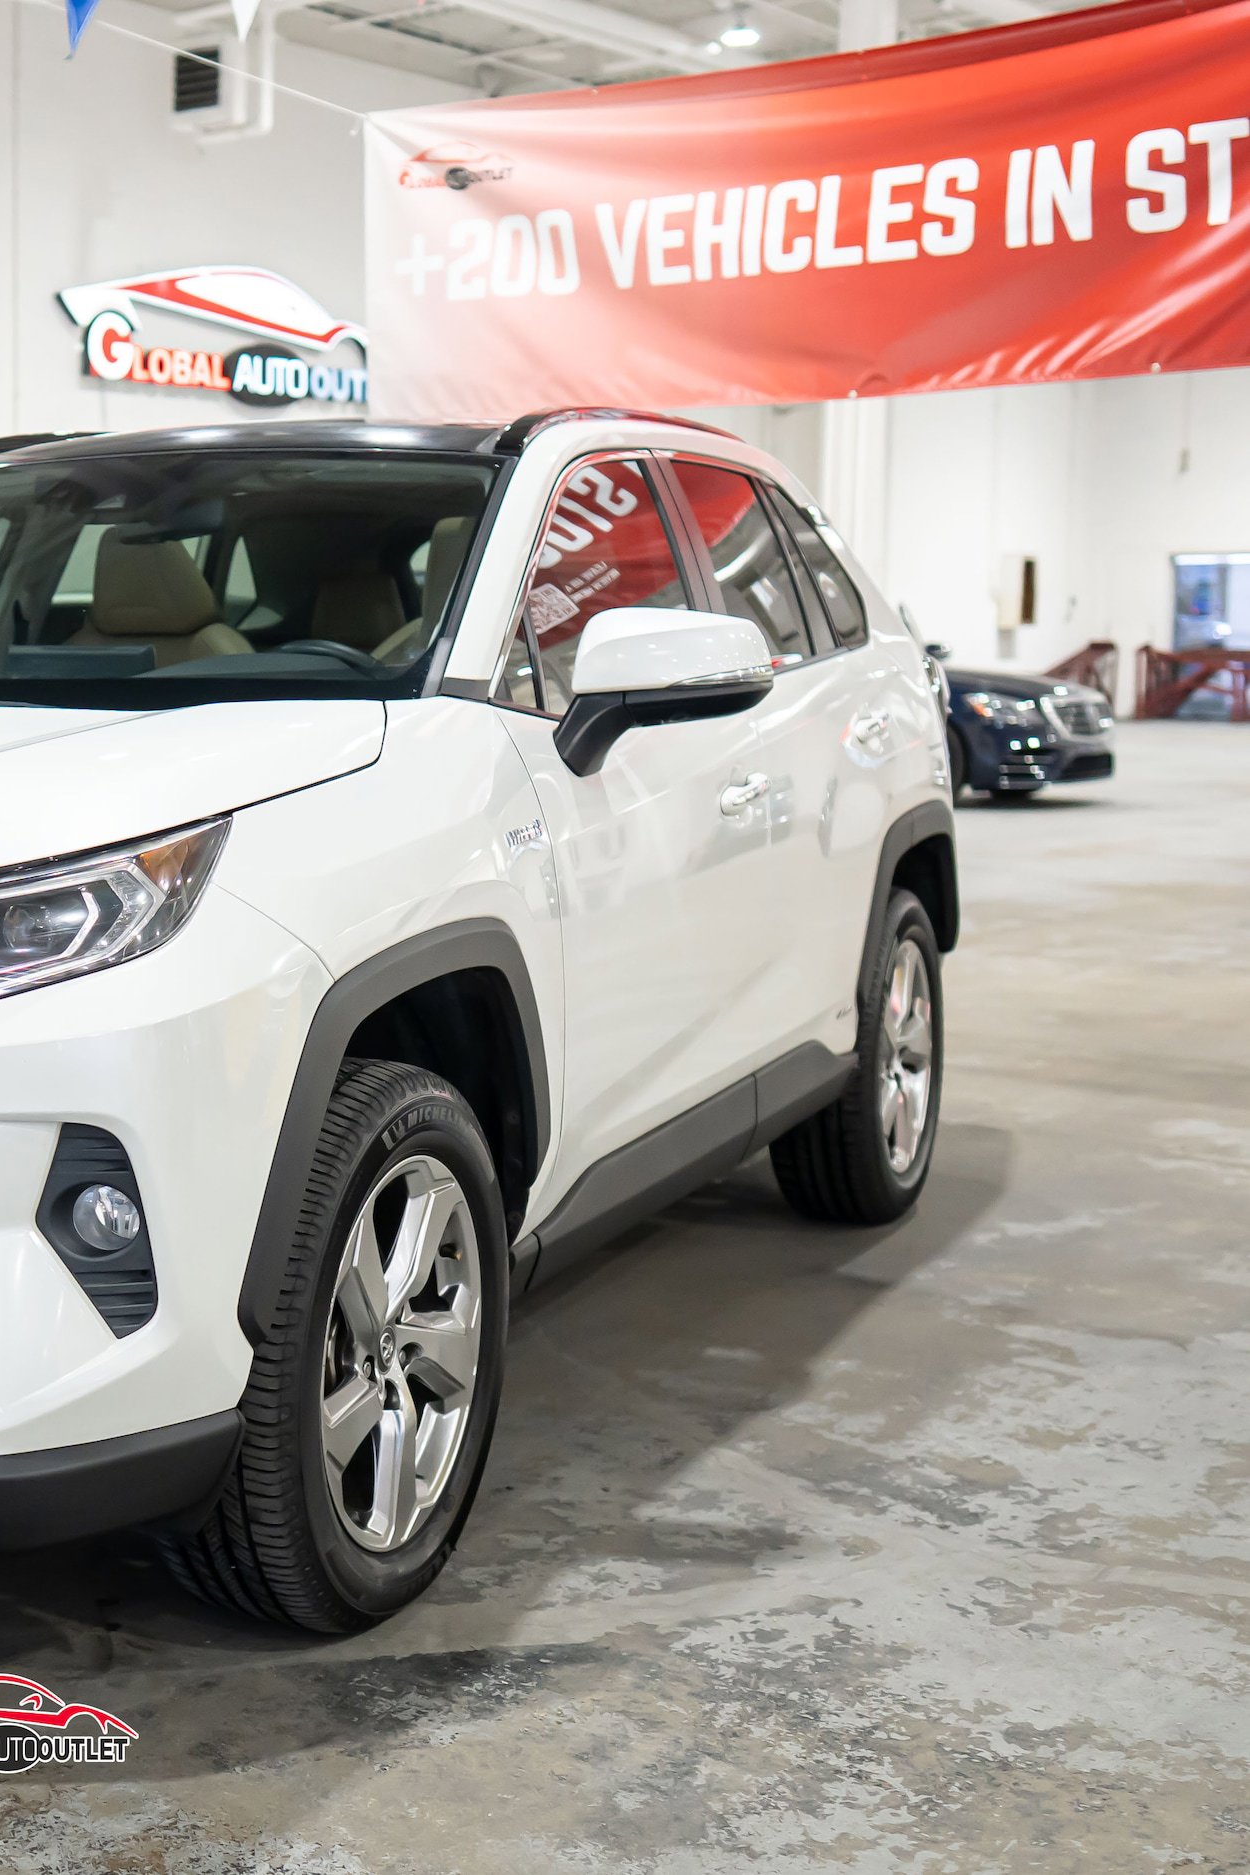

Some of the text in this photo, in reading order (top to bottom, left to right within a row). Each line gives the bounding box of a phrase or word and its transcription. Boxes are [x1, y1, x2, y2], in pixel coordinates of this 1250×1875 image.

[394, 117, 1250, 302] +200 VEHICLES IN ST
[85, 310, 232, 391] GLOBAL
[232, 353, 310, 399] AUTO
